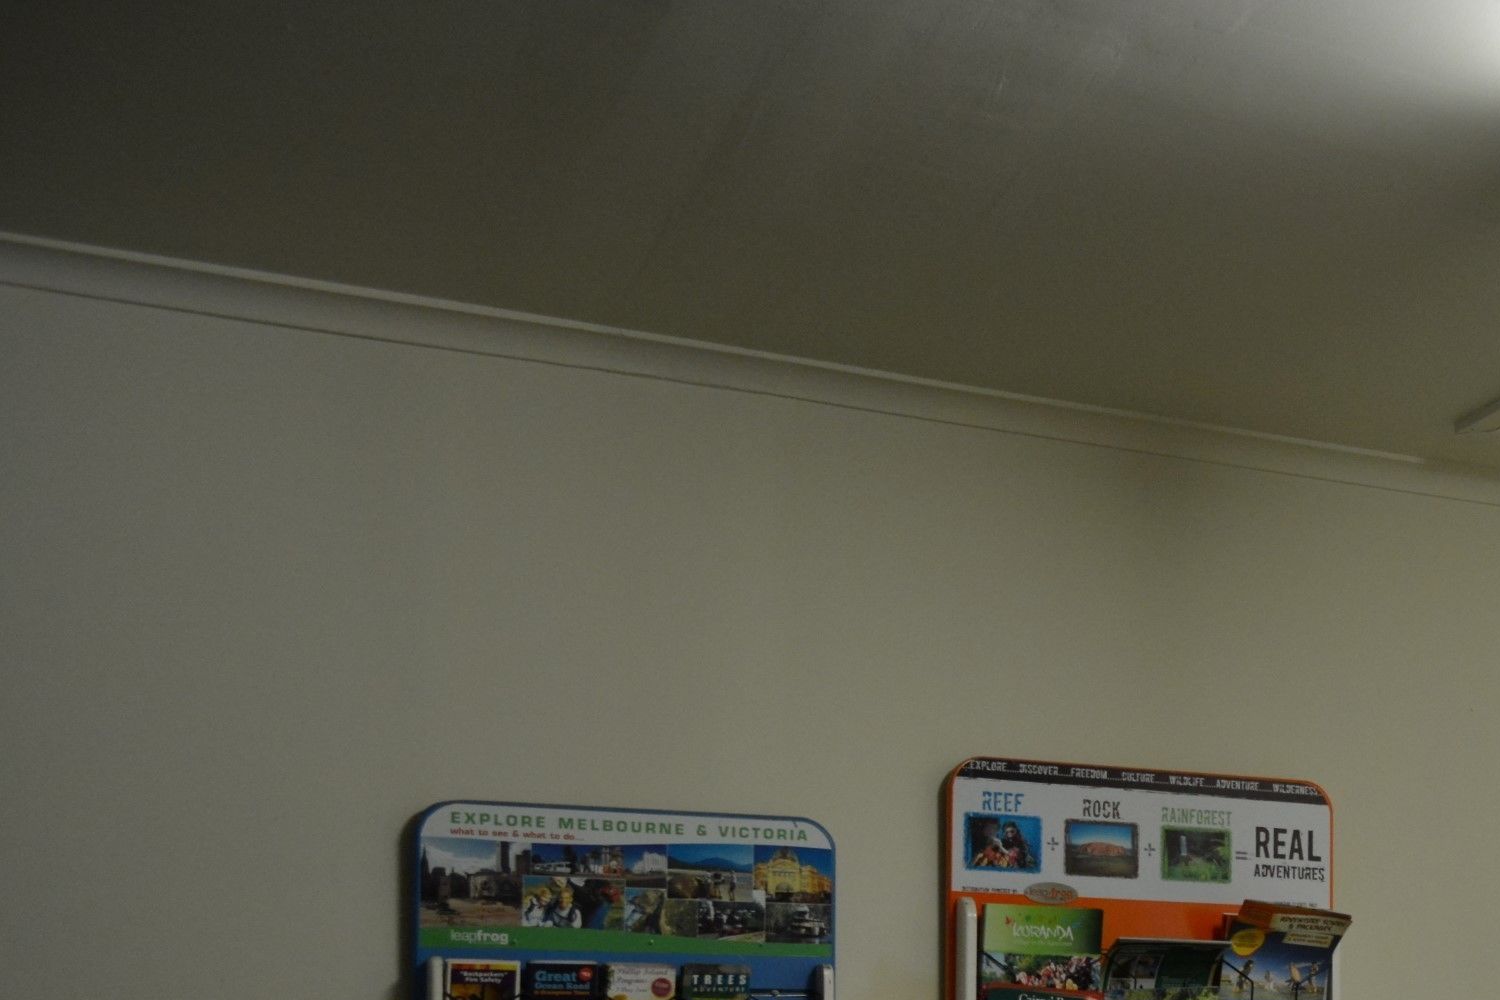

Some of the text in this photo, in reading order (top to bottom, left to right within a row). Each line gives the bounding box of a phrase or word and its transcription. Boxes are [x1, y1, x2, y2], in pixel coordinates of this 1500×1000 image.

[982, 791, 1024, 812] REEF
[1083, 799, 1121, 819] ROCK
[1161, 807, 1232, 825] RAINFOREST
[450, 828, 474, 836] what
[479, 829, 488, 837] to
[523, 831, 546, 839] what
[550, 832, 560, 840] to
[451, 811, 808, 841] EXPLORE MELBOURNE & VICTORIA
[1255, 826, 1321, 862] REAL
[1254, 864, 1325, 882] ADVENTURES
[451, 929, 509, 945] leapfrog
[535, 969, 577, 982] Great
[692, 974, 747, 985] TREES
[564, 982, 590, 990] Road
